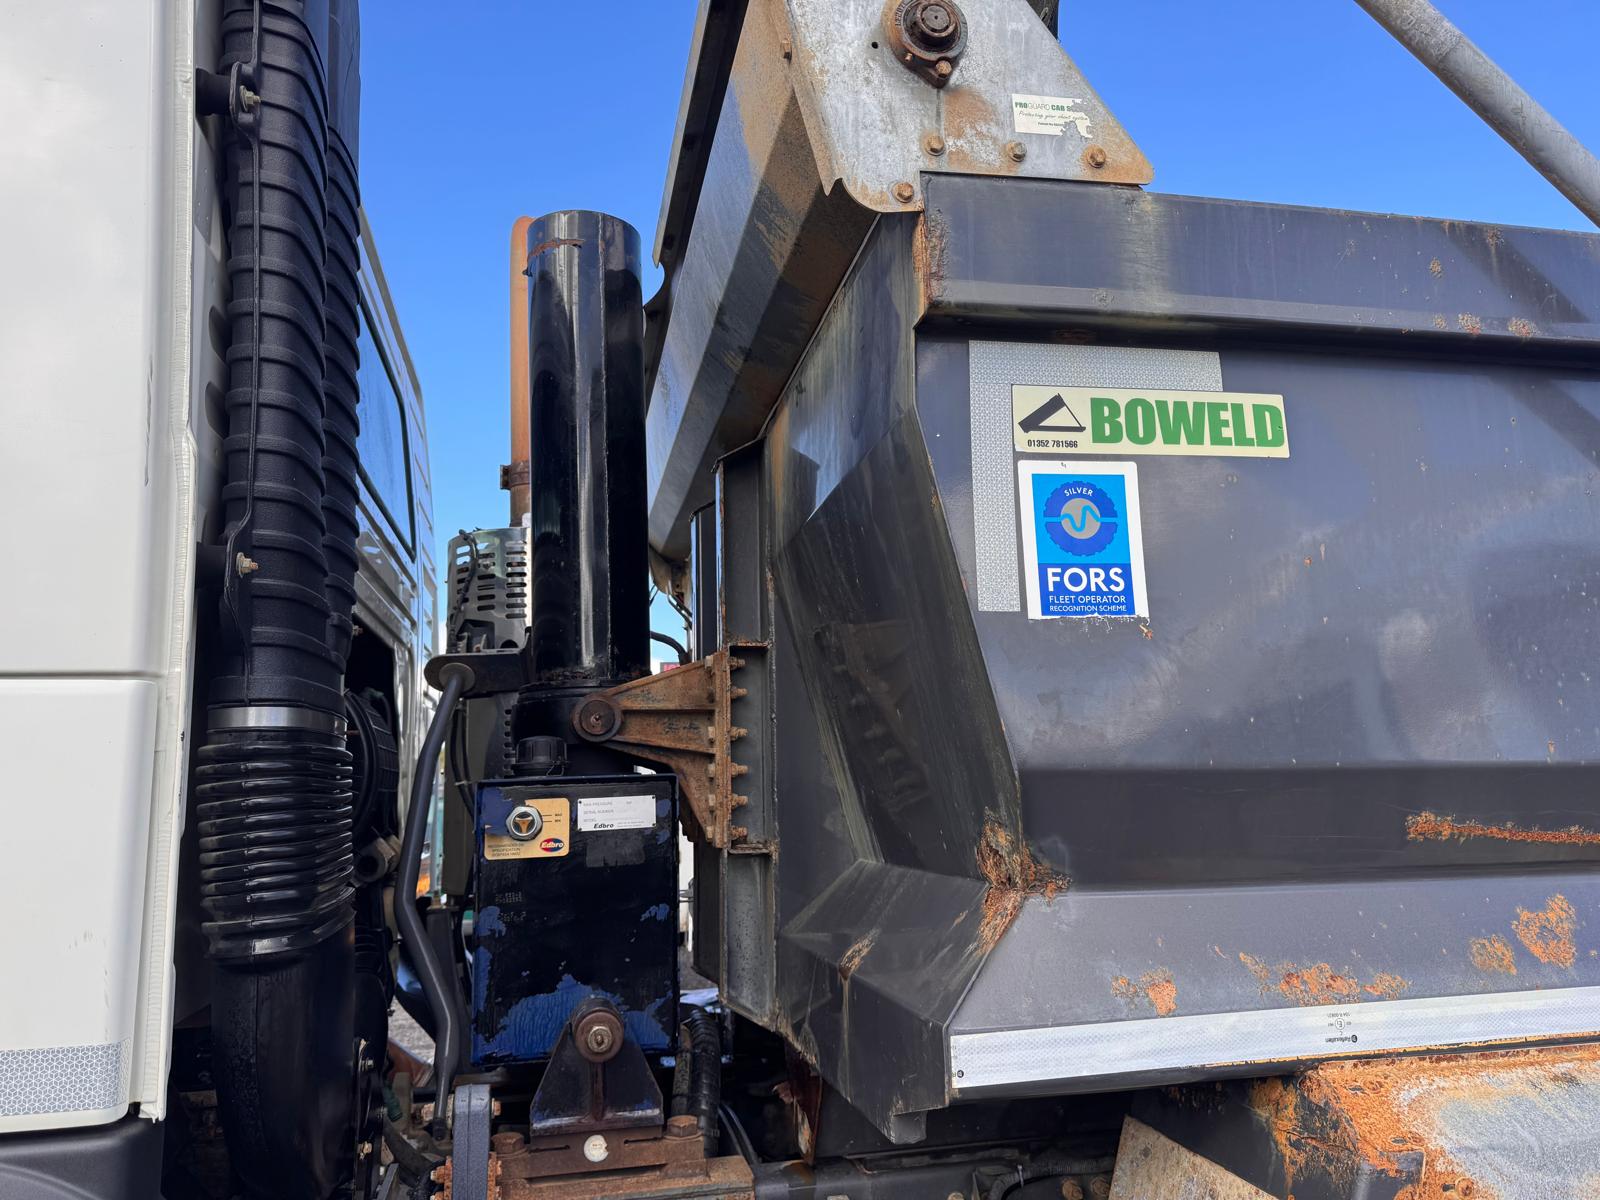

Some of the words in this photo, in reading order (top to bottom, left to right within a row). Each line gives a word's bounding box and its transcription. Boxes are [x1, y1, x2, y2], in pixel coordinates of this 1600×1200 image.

[1015, 102, 1050, 110] PROGUARD
[1090, 397, 1285, 448] BOWELD
[1027, 439, 1050, 447] 01352
[1051, 440, 1078, 448] 781566
[1064, 487, 1093, 497] SILVER
[1047, 567, 1125, 592] FORS
[1049, 595, 1076, 604] FLEET
[1077, 595, 1126, 604] OPERATOR
[541, 841, 564, 849] Edbro
